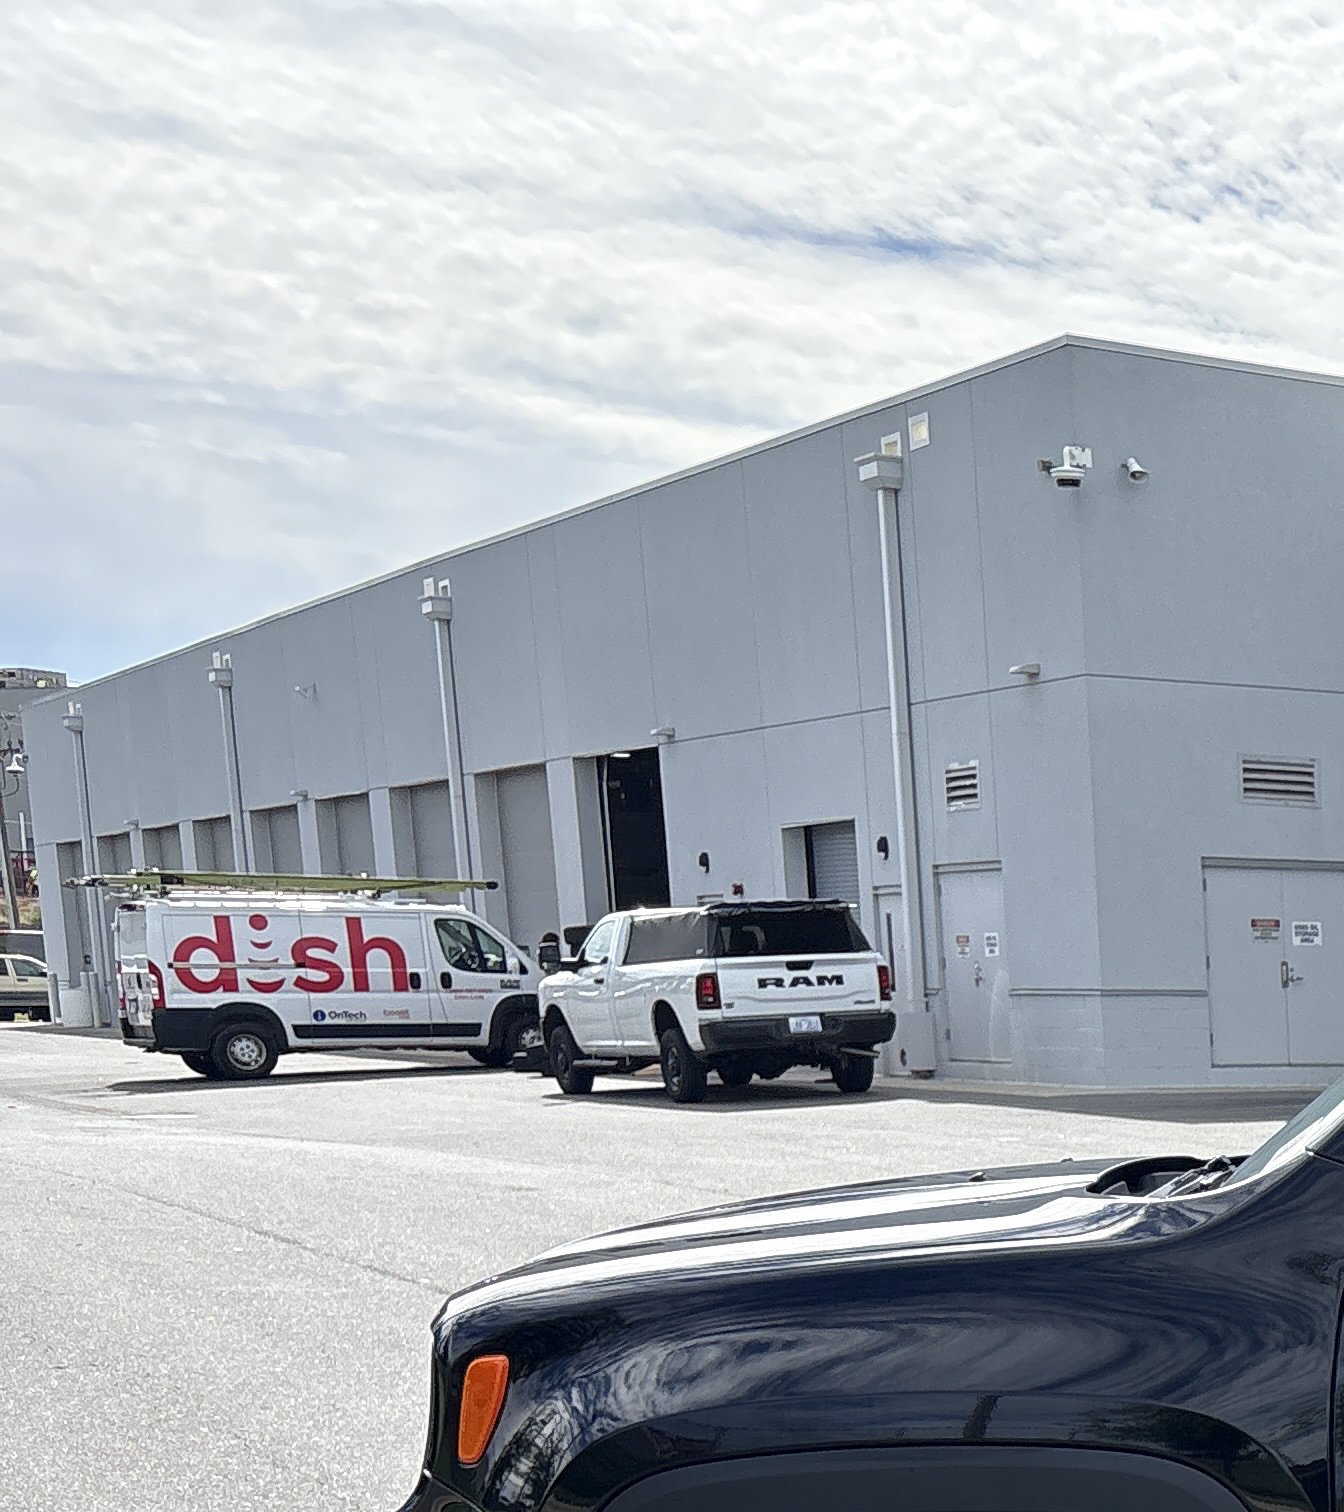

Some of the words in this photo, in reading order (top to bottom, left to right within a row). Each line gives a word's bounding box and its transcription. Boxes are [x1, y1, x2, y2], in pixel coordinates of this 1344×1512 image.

[172, 913, 411, 994] dish
[757, 974, 845, 989] RAM
[328, 1009, 367, 1021] OnTech
